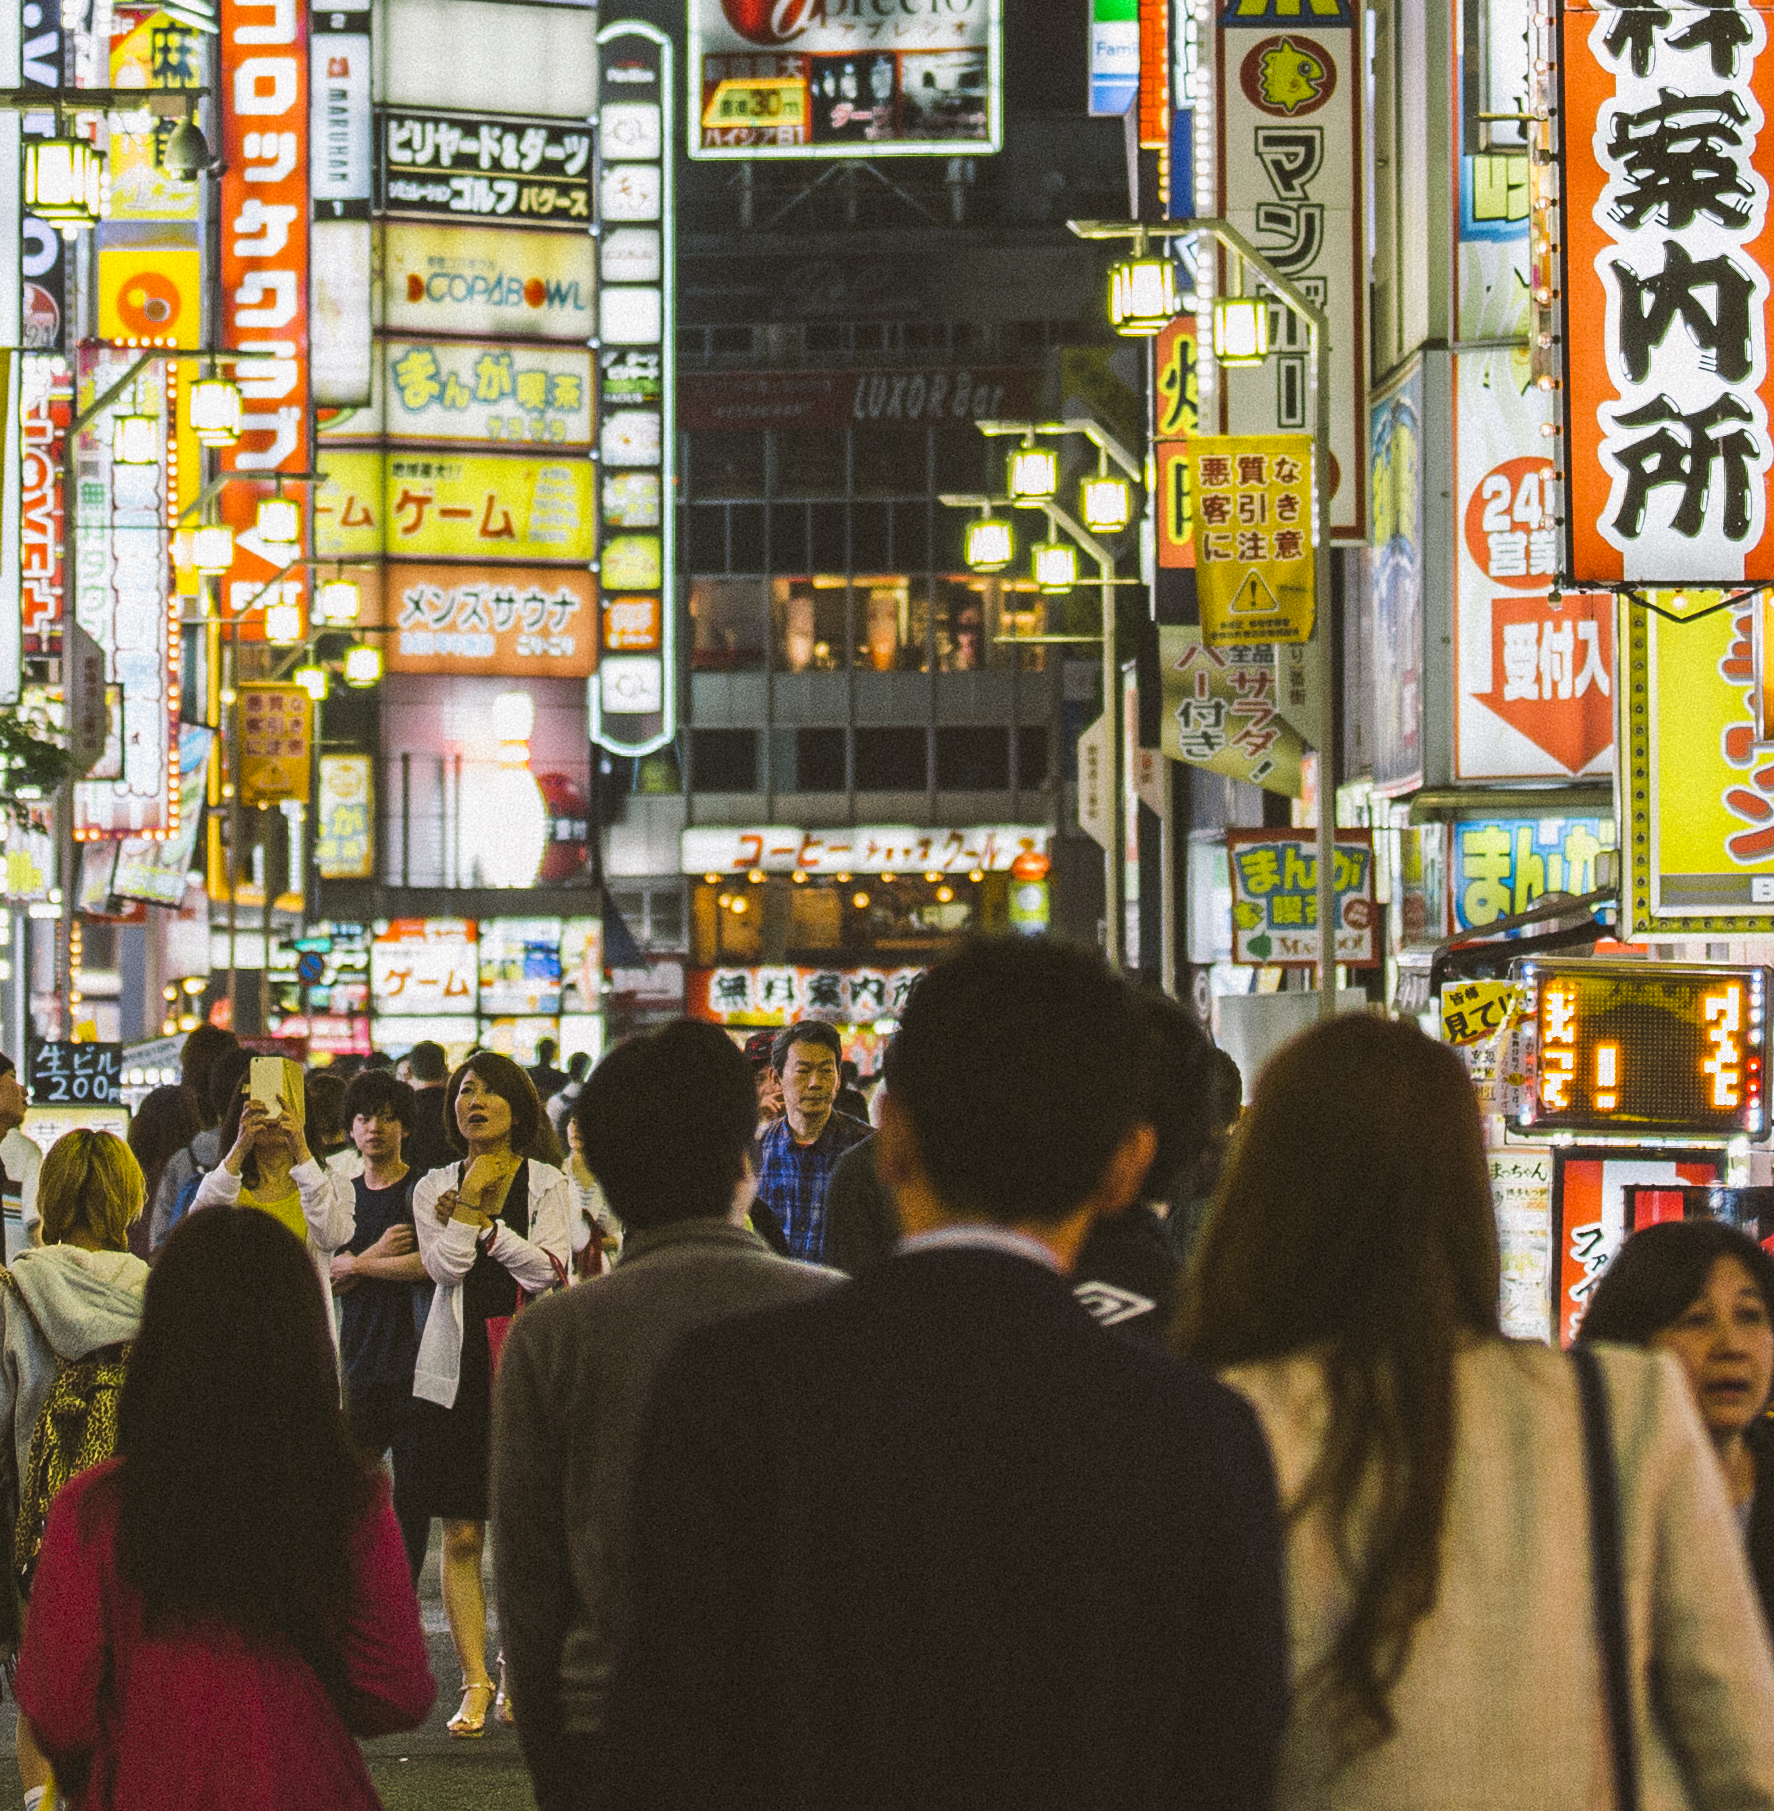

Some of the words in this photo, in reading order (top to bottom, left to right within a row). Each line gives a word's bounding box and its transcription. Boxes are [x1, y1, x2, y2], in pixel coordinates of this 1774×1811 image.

[388, 118, 590, 177] ビリヤード&ダーツ
[448, 175, 517, 216] ゴルフ
[392, 346, 585, 413] まんが喫茶
[1199, 454, 1300, 489] 悪質な
[393, 488, 516, 540] ゲーム
[1201, 494, 1303, 524] 客引き
[1202, 531, 1307, 561] に注意
[383, 968, 468, 997] ゲーム
